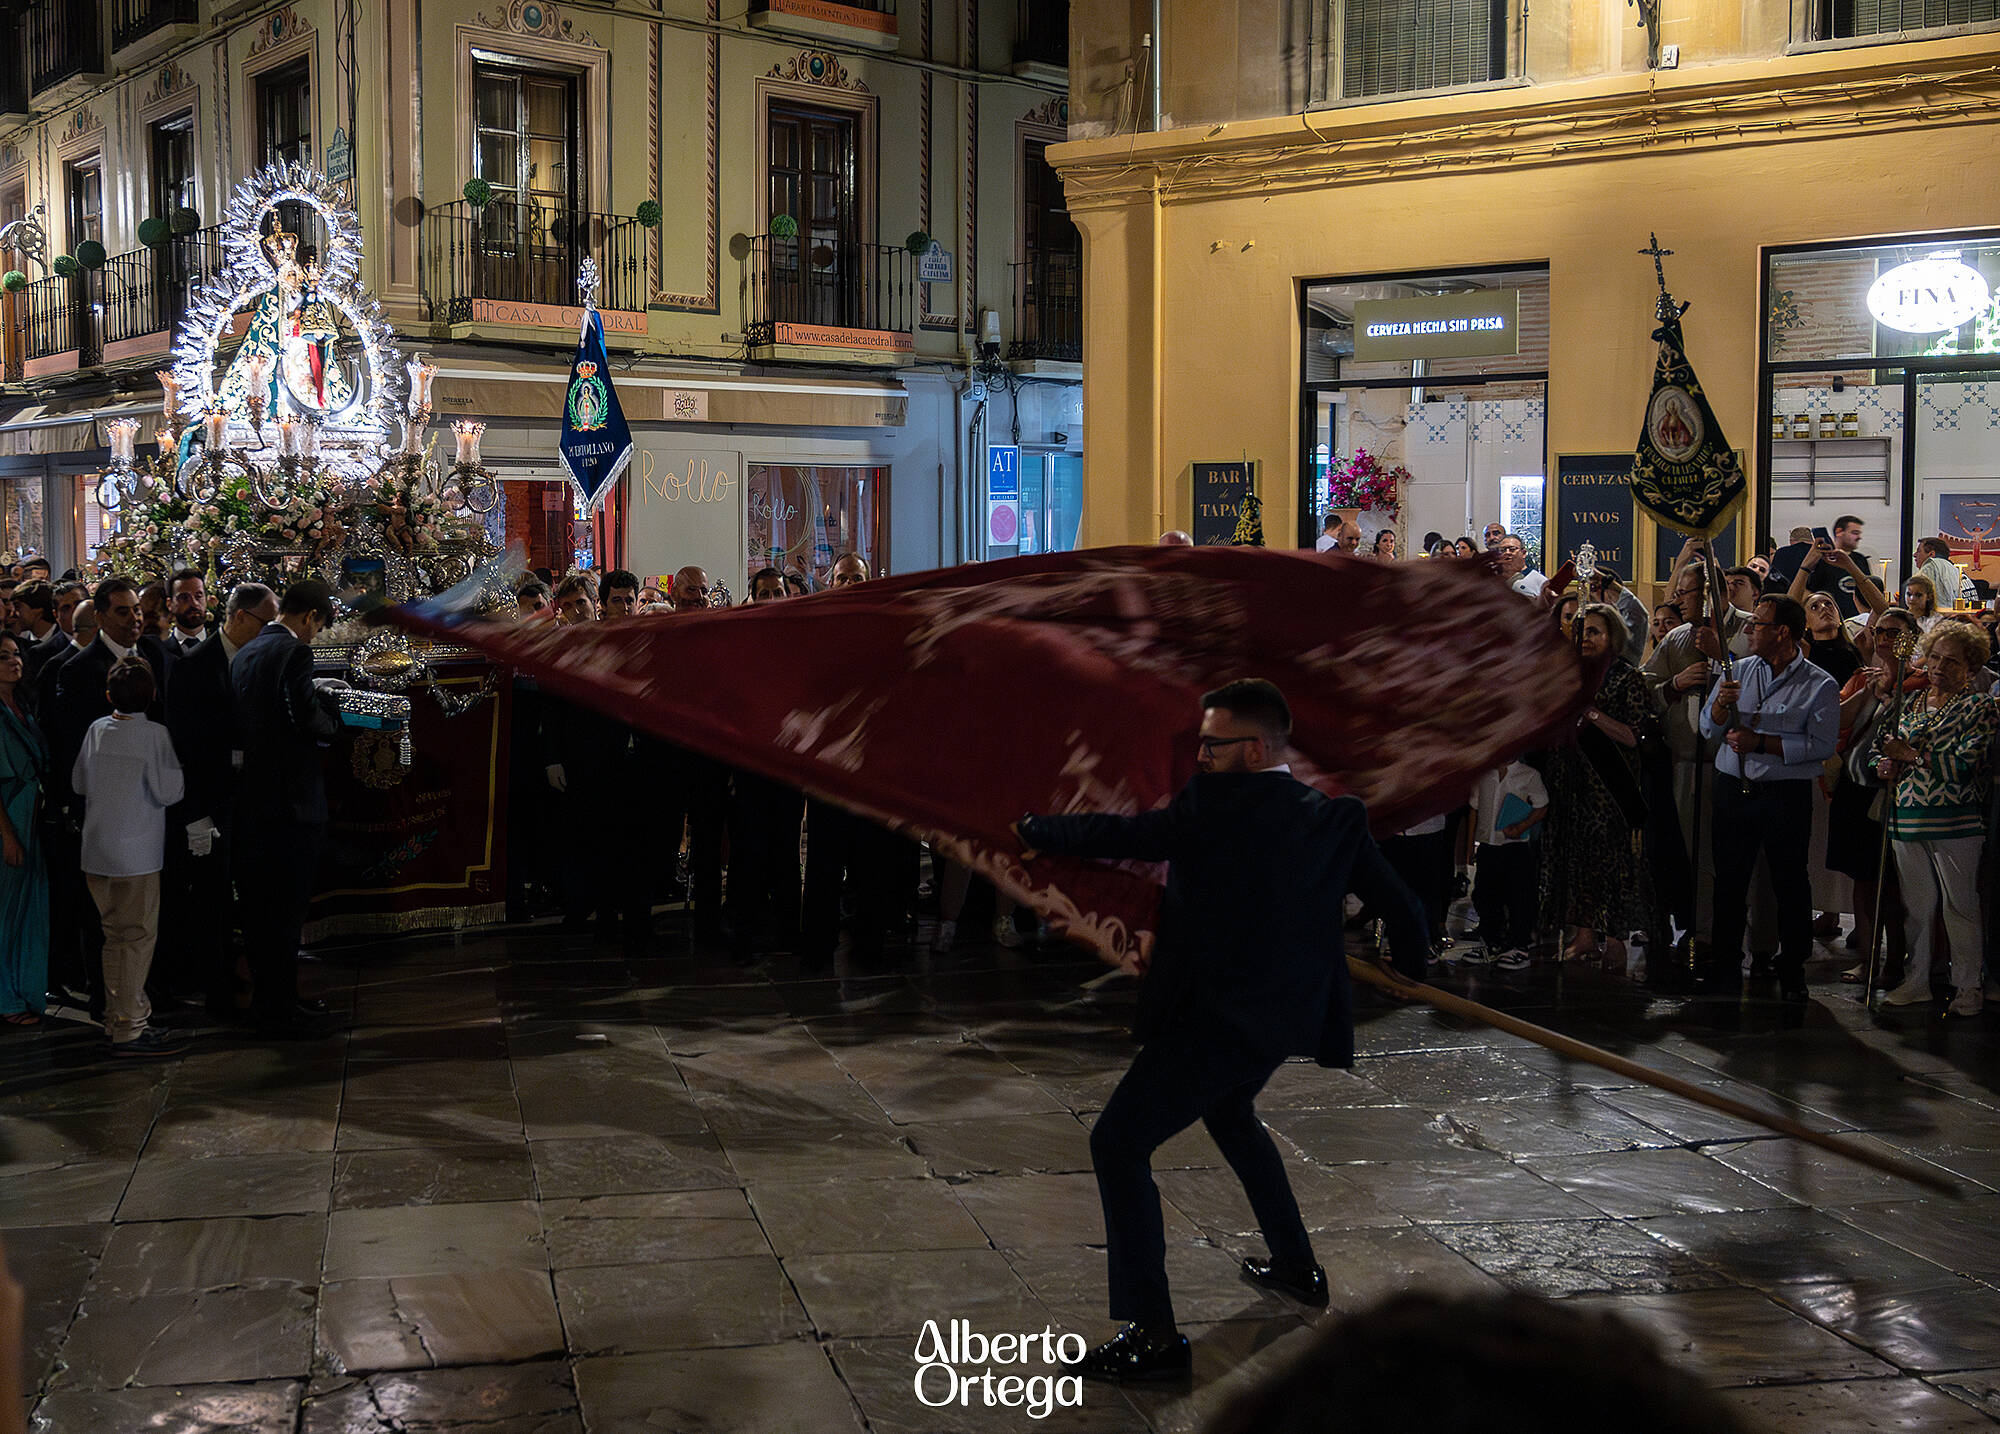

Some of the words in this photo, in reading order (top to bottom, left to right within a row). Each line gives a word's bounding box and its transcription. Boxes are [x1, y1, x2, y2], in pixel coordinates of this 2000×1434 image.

[496, 305, 543, 323] CASA
[561, 309, 643, 331] CADRAL
[1366, 322, 1411, 337] CERVEZA
[1412, 320, 1447, 334] HECHA
[1448, 318, 1468, 332] SIN
[1470, 316, 1504, 331] PRISA
[795, 329, 912, 348] www.casadelacatedral.com
[992, 451, 1014, 472] AT
[642, 450, 736, 505] Rollo
[1208, 471, 1240, 483] BAR
[1563, 474, 1631, 486] CERVEZAS
[753, 493, 798, 521] Rollo
[1200, 504, 1239, 517] TAPA
[1572, 511, 1620, 524] VINOS
[1569, 547, 1622, 562] VRMÚ
